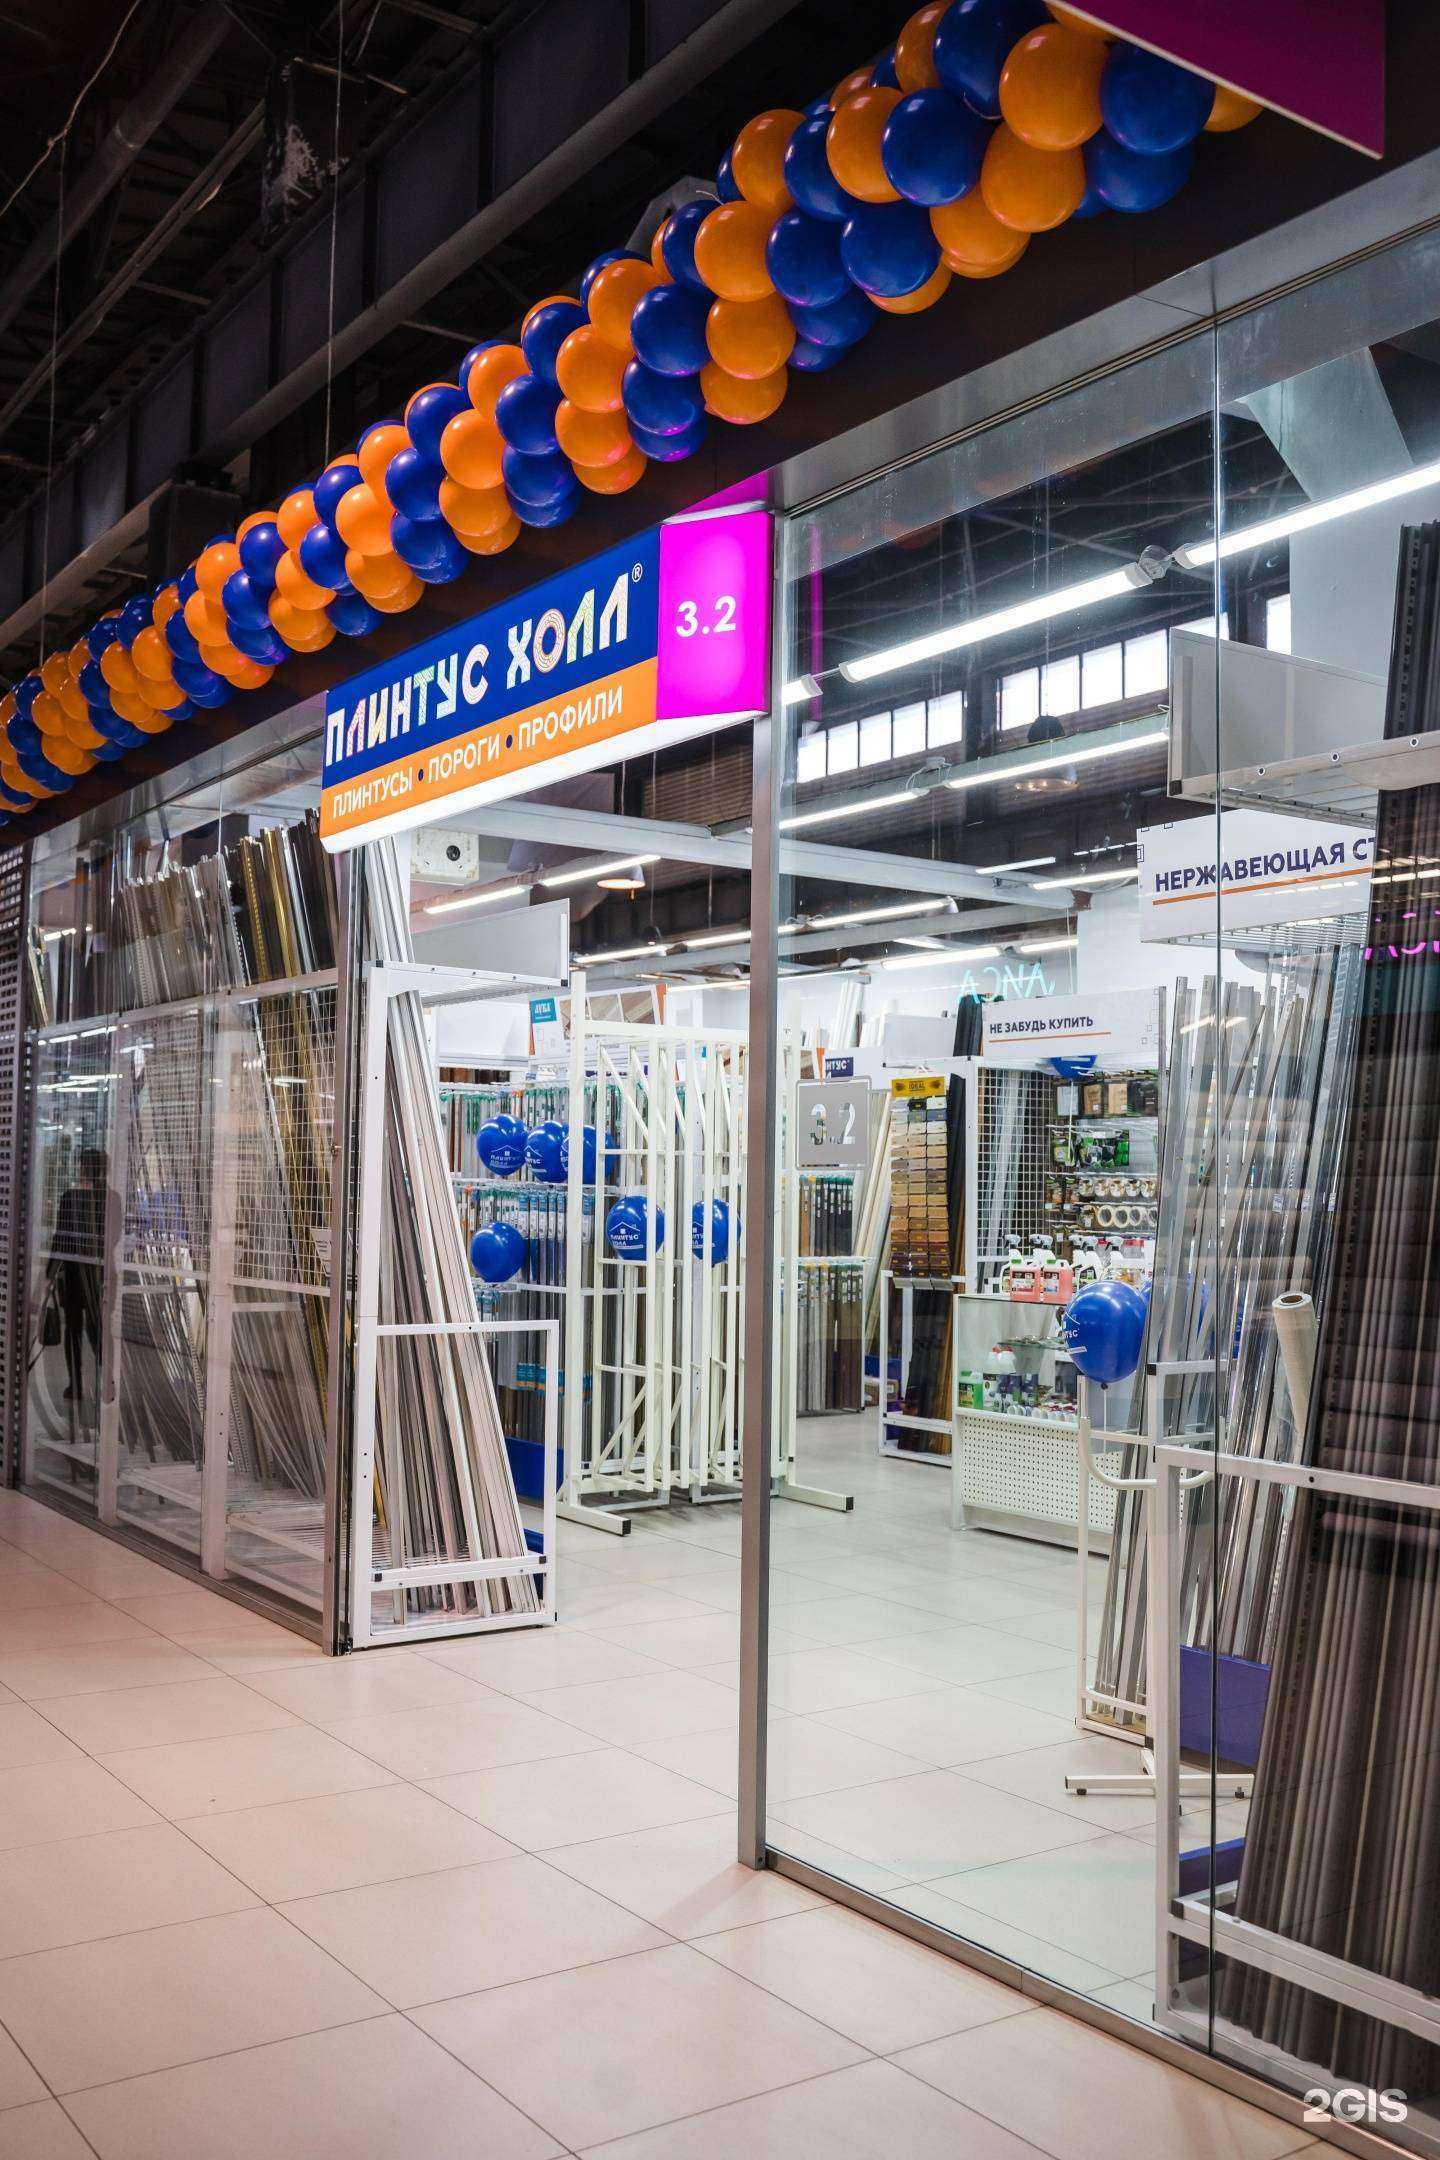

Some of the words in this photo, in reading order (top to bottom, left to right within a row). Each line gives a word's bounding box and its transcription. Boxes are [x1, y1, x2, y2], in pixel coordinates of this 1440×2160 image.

[675, 595, 737, 638] 3.2
[325, 643, 490, 767] ПЛИНТУС
[332, 767, 413, 818] ПЛИНТУСЫ
[428, 733, 500, 784] ПОРОГИ
[518, 686, 623, 751] ПРОФИЛИ
[1155, 842, 1345, 893] НЕРЖАВЕЮЩАЯ
[989, 1023, 1003, 1034] НЕ
[1004, 1020, 1047, 1034] ЗАБУДЬ
[1049, 1016, 1094, 1030] КУПИТЬ
